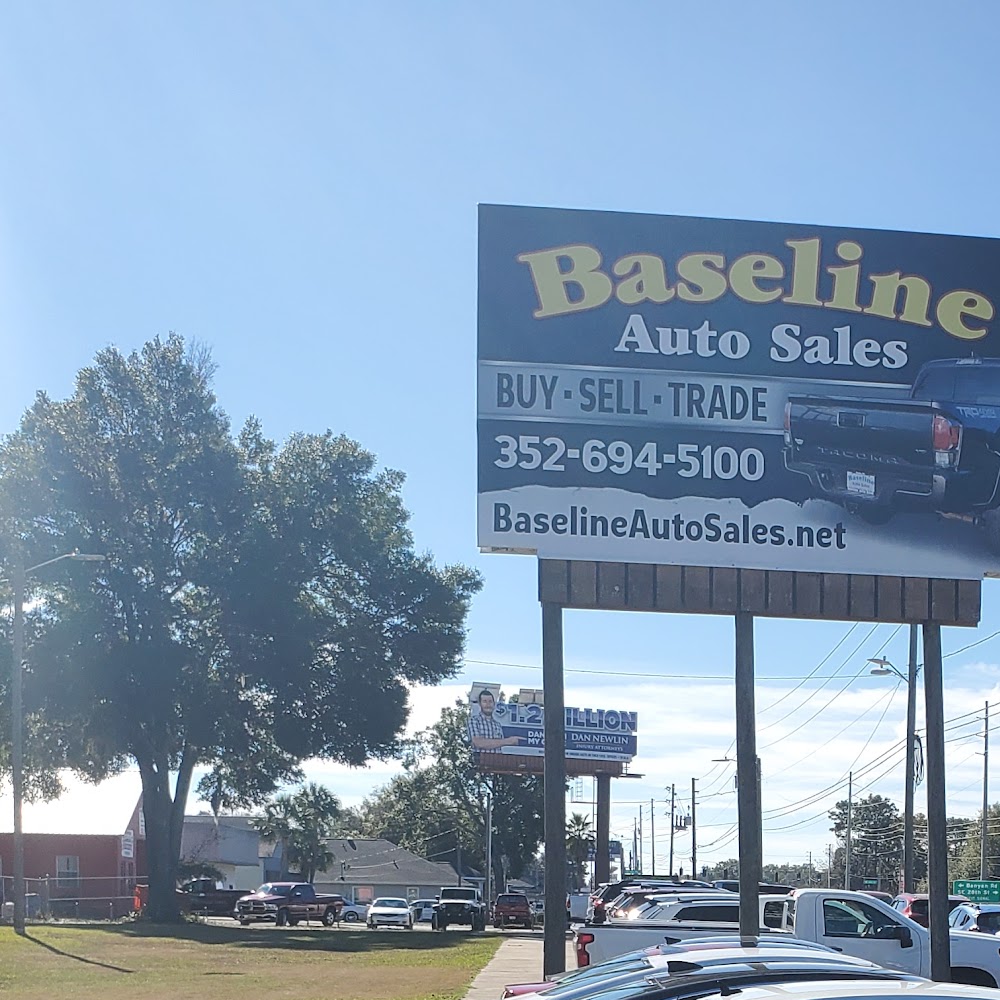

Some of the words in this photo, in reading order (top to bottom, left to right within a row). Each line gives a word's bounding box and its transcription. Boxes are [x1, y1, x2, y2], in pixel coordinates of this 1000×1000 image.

[517, 237, 996, 339] Baseline
[614, 314, 750, 360] Auto
[770, 324, 909, 369] Sales
[496, 372, 558, 411] BUY
[580, 378, 648, 416] SELL
[668, 381, 768, 423] TRADE
[493, 434, 766, 481] 352-694-5100
[492, 502, 848, 549] BaselineAutoSales.net
[565, 708, 637, 731] ILLION
[571, 733, 591, 742] DAN
[593, 734, 629, 744] NEWLIN
